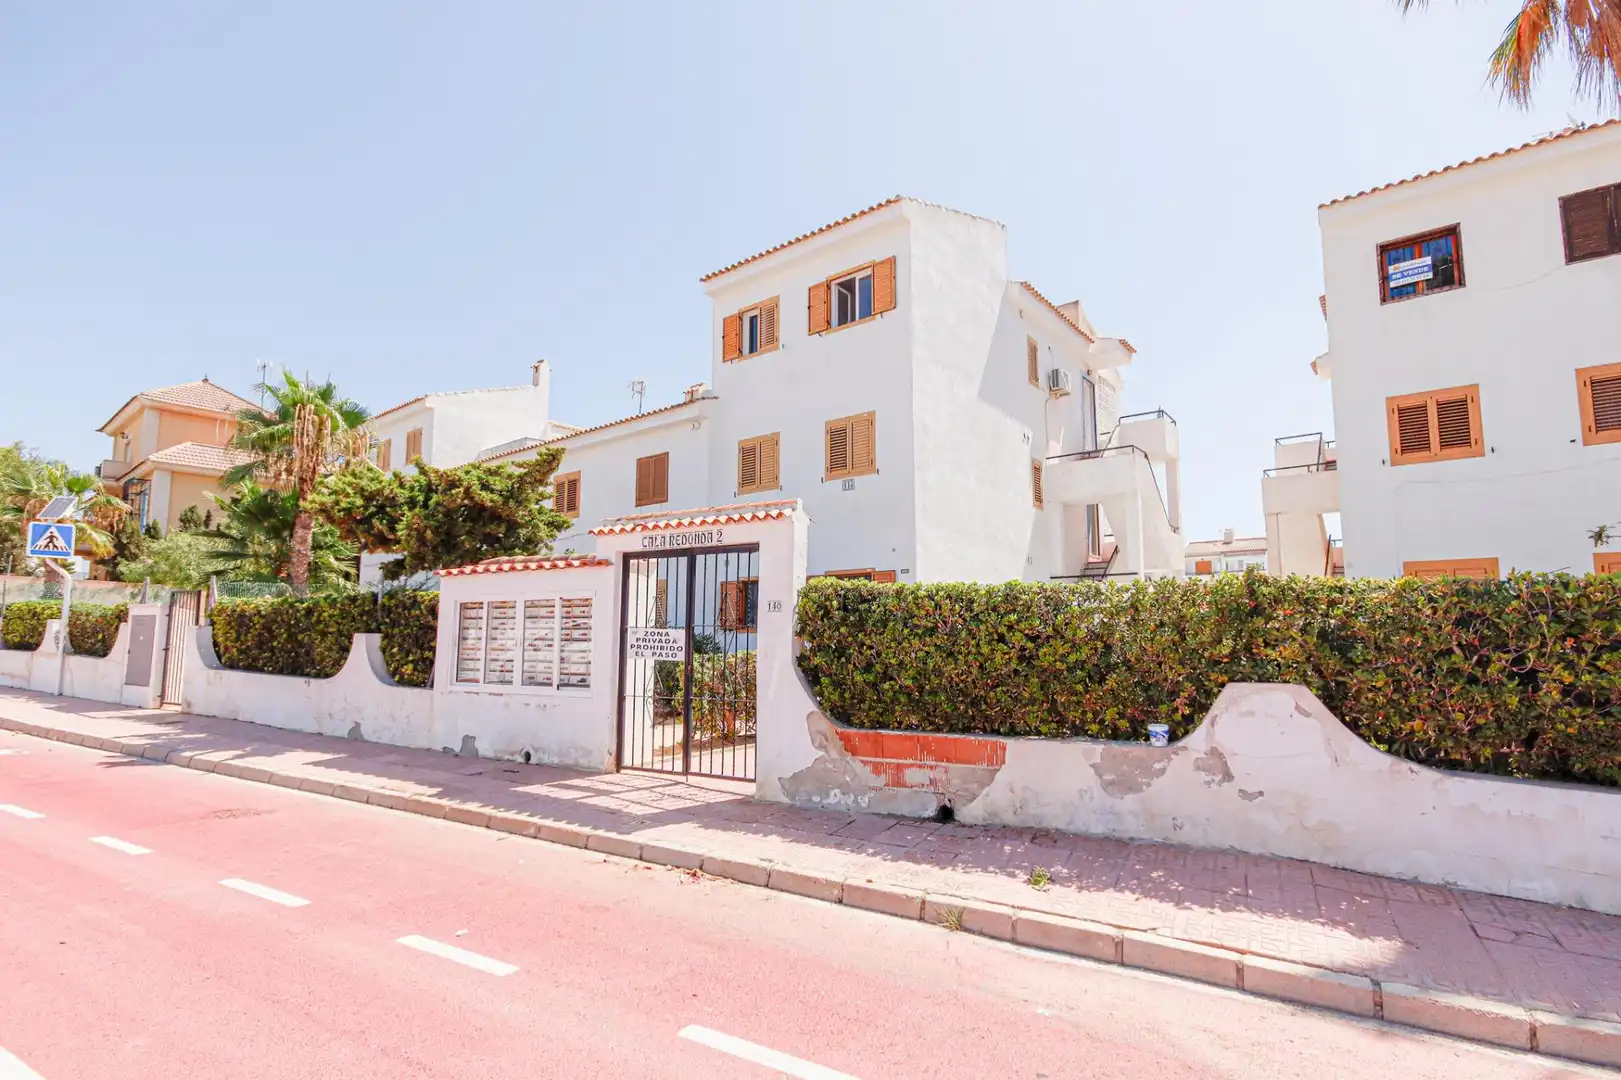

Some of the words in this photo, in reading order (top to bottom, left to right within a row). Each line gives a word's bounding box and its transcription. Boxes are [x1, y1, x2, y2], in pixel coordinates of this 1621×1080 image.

[1403, 267, 1429, 276] VENDE
[641, 535, 666, 549] CALA
[669, 531, 713, 548] REDONDA
[716, 529, 723, 544] 2
[767, 600, 782, 611] 140
[630, 644, 684, 652] PROHIBIDO
